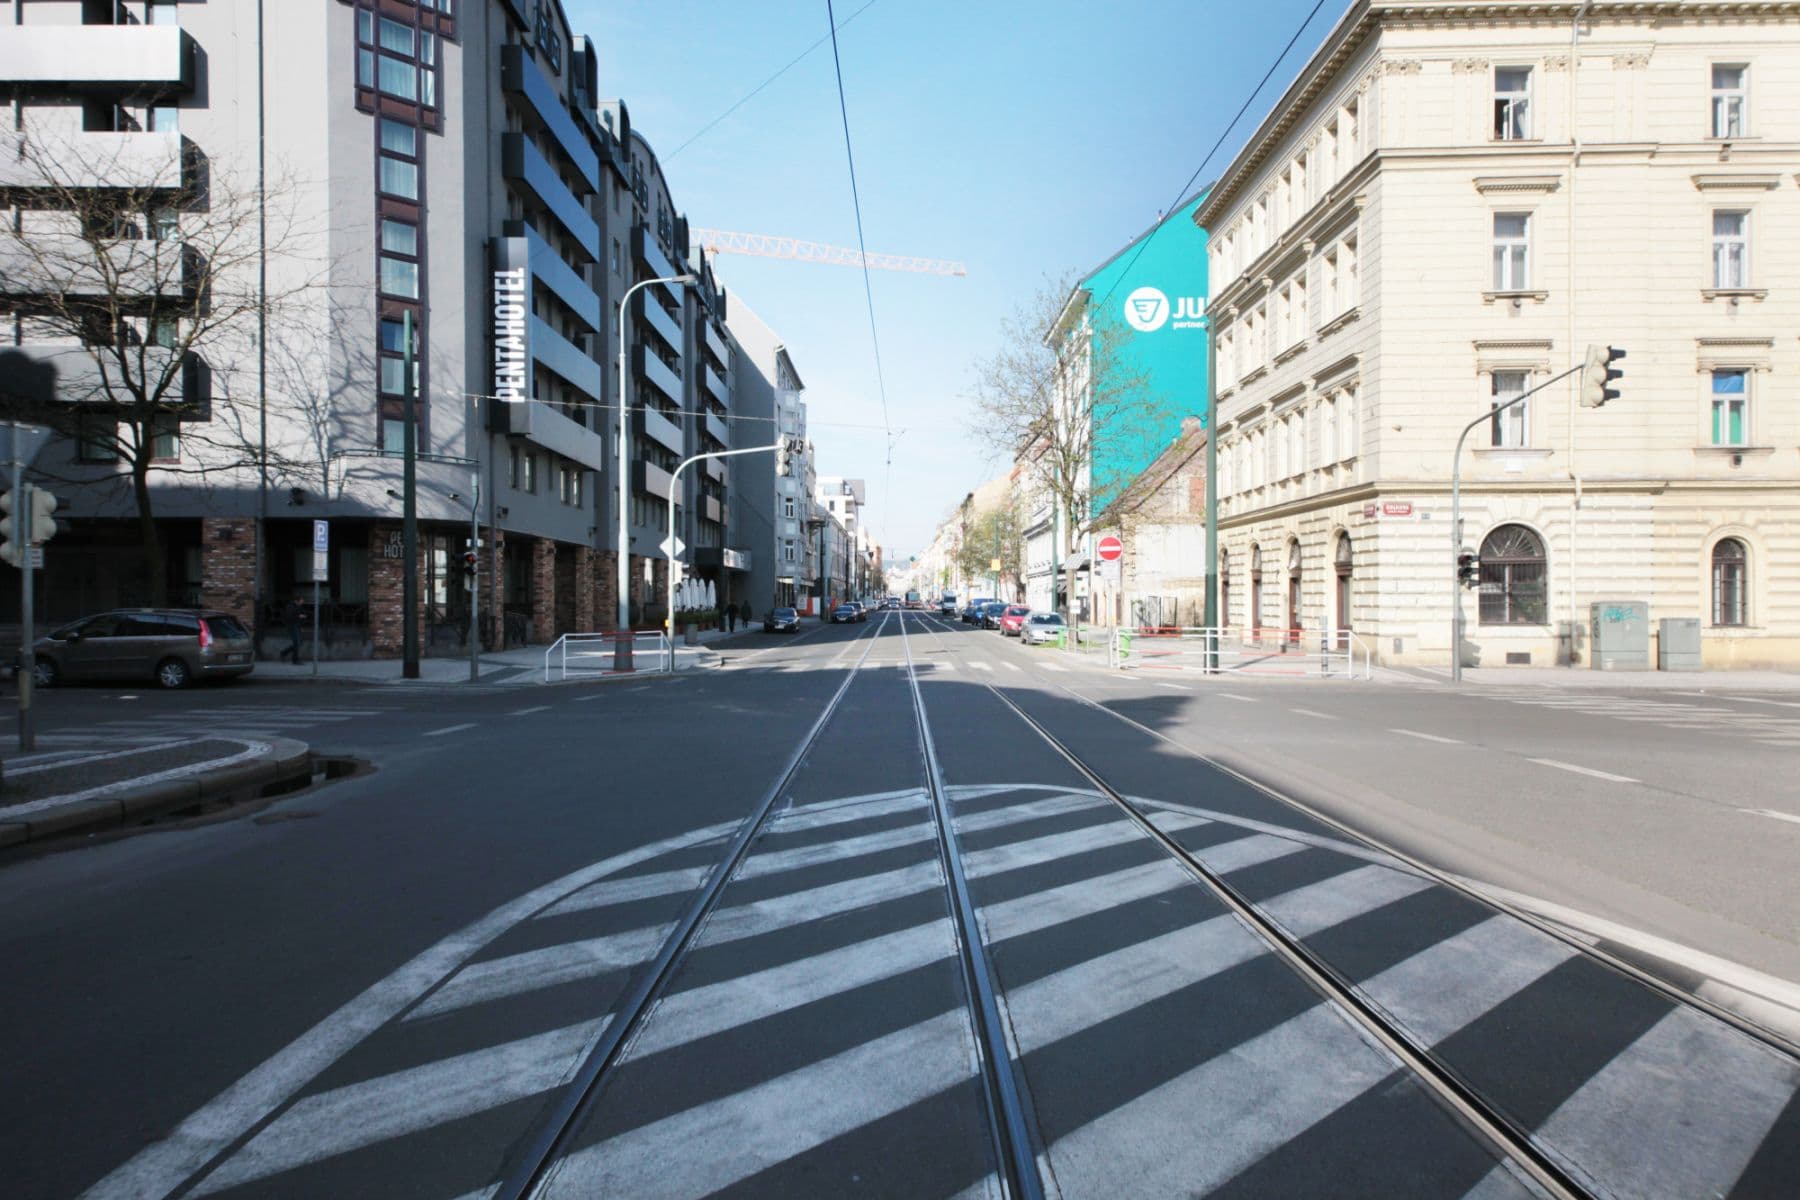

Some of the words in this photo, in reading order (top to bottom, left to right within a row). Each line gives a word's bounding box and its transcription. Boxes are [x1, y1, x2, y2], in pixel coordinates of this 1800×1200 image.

[1172, 297, 1210, 319] JU
[494, 267, 526, 403] PENTAHOTEL
[389, 529, 421, 545] PEA
